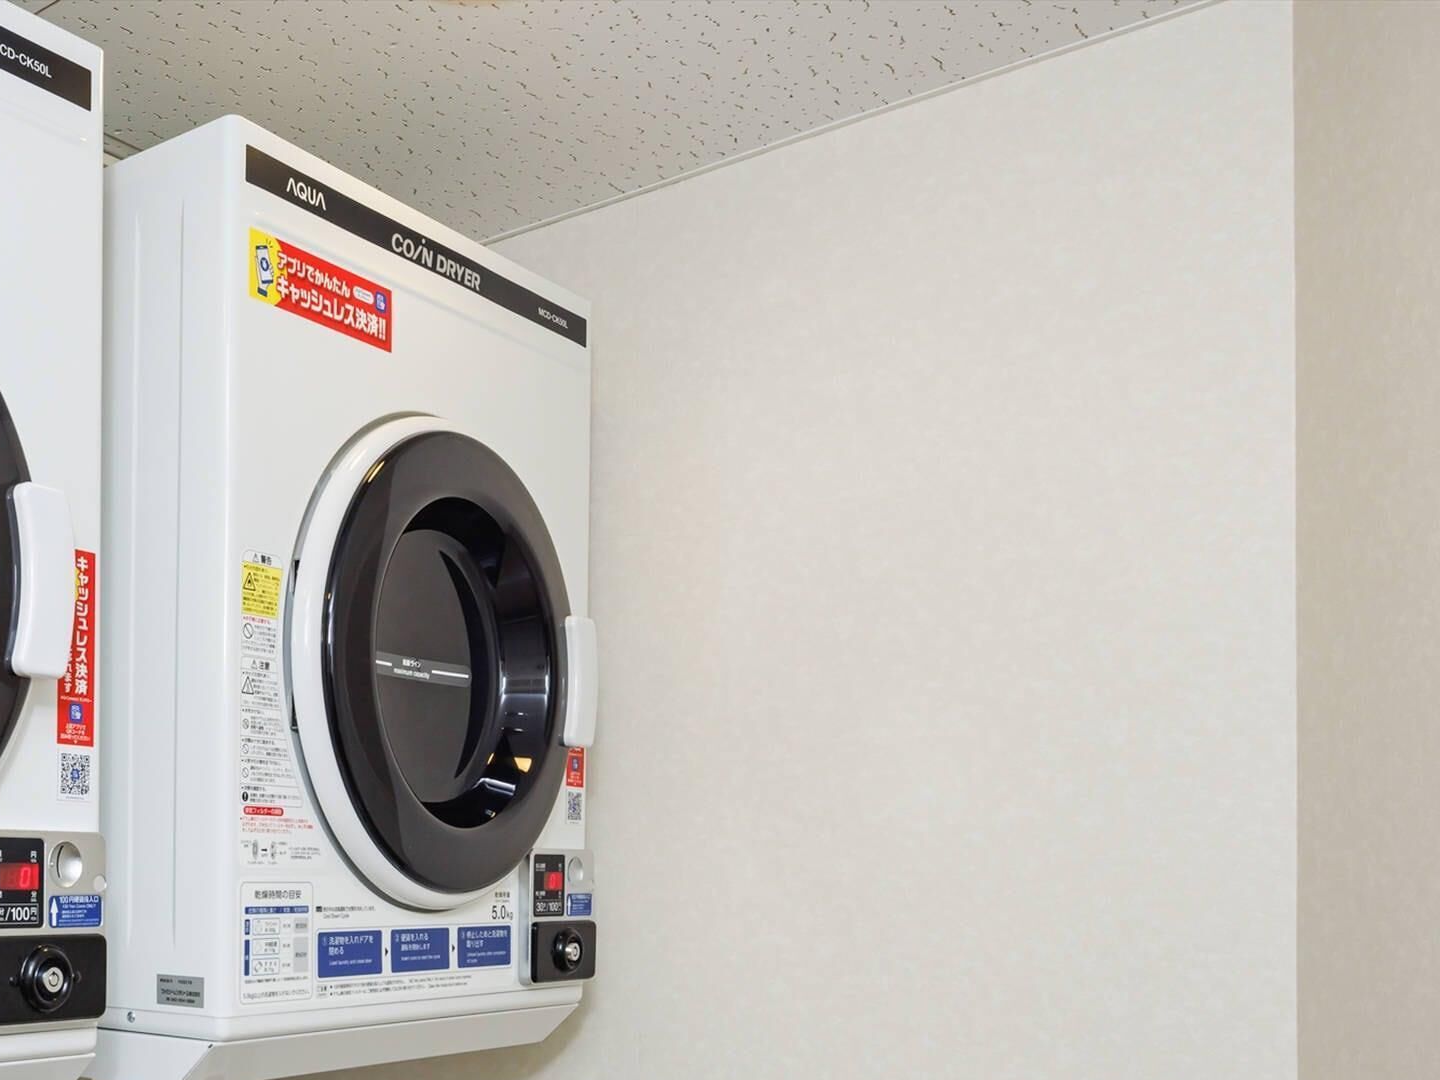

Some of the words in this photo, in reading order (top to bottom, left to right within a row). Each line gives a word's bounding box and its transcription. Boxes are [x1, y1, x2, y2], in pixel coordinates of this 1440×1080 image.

[286, 177, 327, 211] AQUA
[277, 251, 351, 298] アプリでかんたん
[435, 256, 481, 291] DRYER
[30, 850, 37, 858] 円
[19, 866, 31, 888] 0
